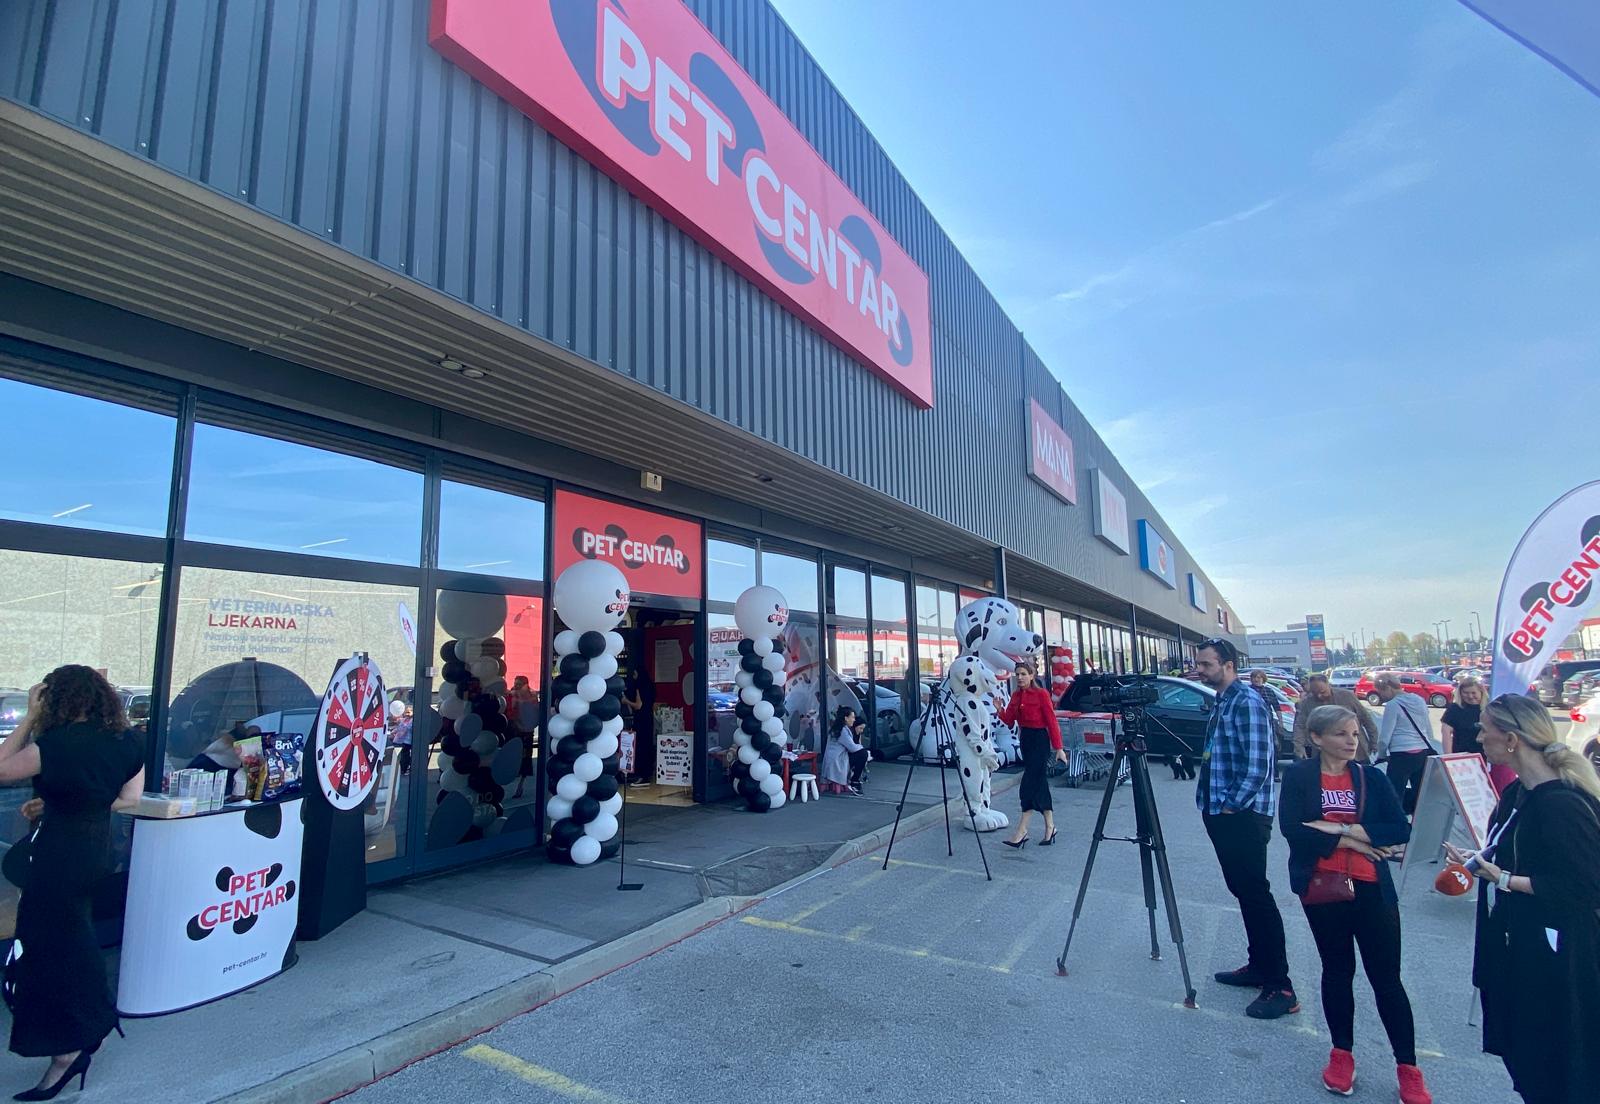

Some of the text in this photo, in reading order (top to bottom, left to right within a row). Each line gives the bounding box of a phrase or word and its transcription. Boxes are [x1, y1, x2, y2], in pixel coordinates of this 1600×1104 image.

[603, 6, 901, 346] PET CENTAR
[583, 531, 685, 569] PET CENTAR
[208, 598, 334, 617] VETERINARSKA
[208, 613, 297, 629] LJEKARNA
[1510, 599, 1555, 655] PET
[230, 867, 270, 896] PET
[200, 884, 286, 928] CENTAR
[222, 951, 268, 975] pet-centar.hr
